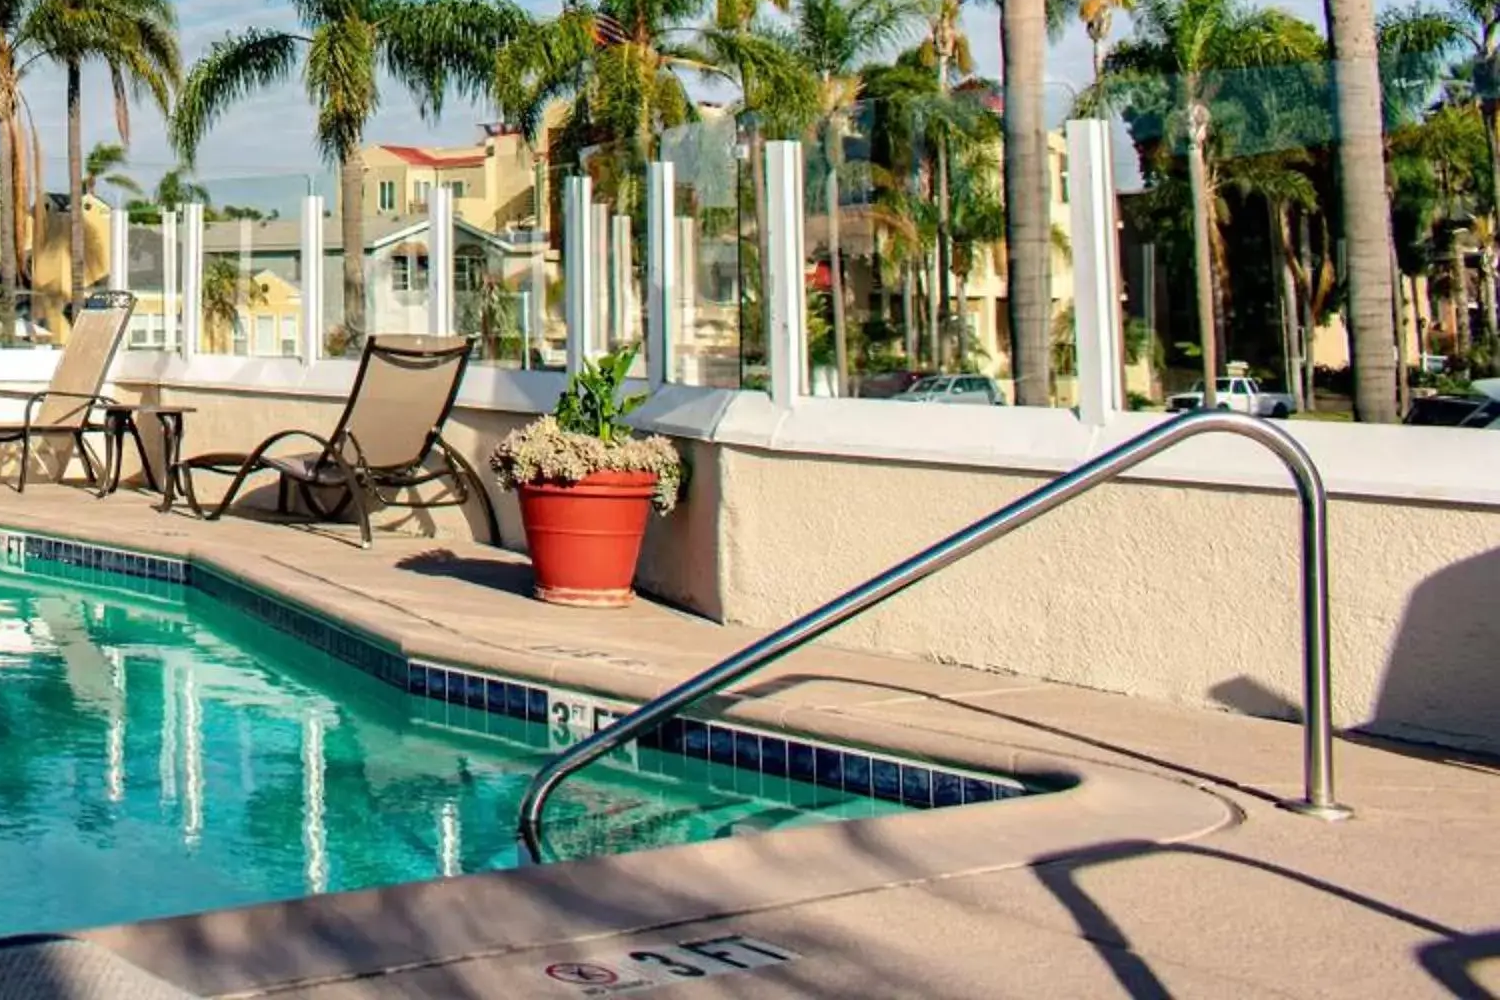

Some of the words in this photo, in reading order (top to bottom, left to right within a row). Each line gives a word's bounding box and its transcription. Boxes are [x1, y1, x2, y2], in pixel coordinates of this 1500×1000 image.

[552, 702, 570, 746] 3
[629, 952, 706, 977] 3
[678, 935, 790, 969] FT
